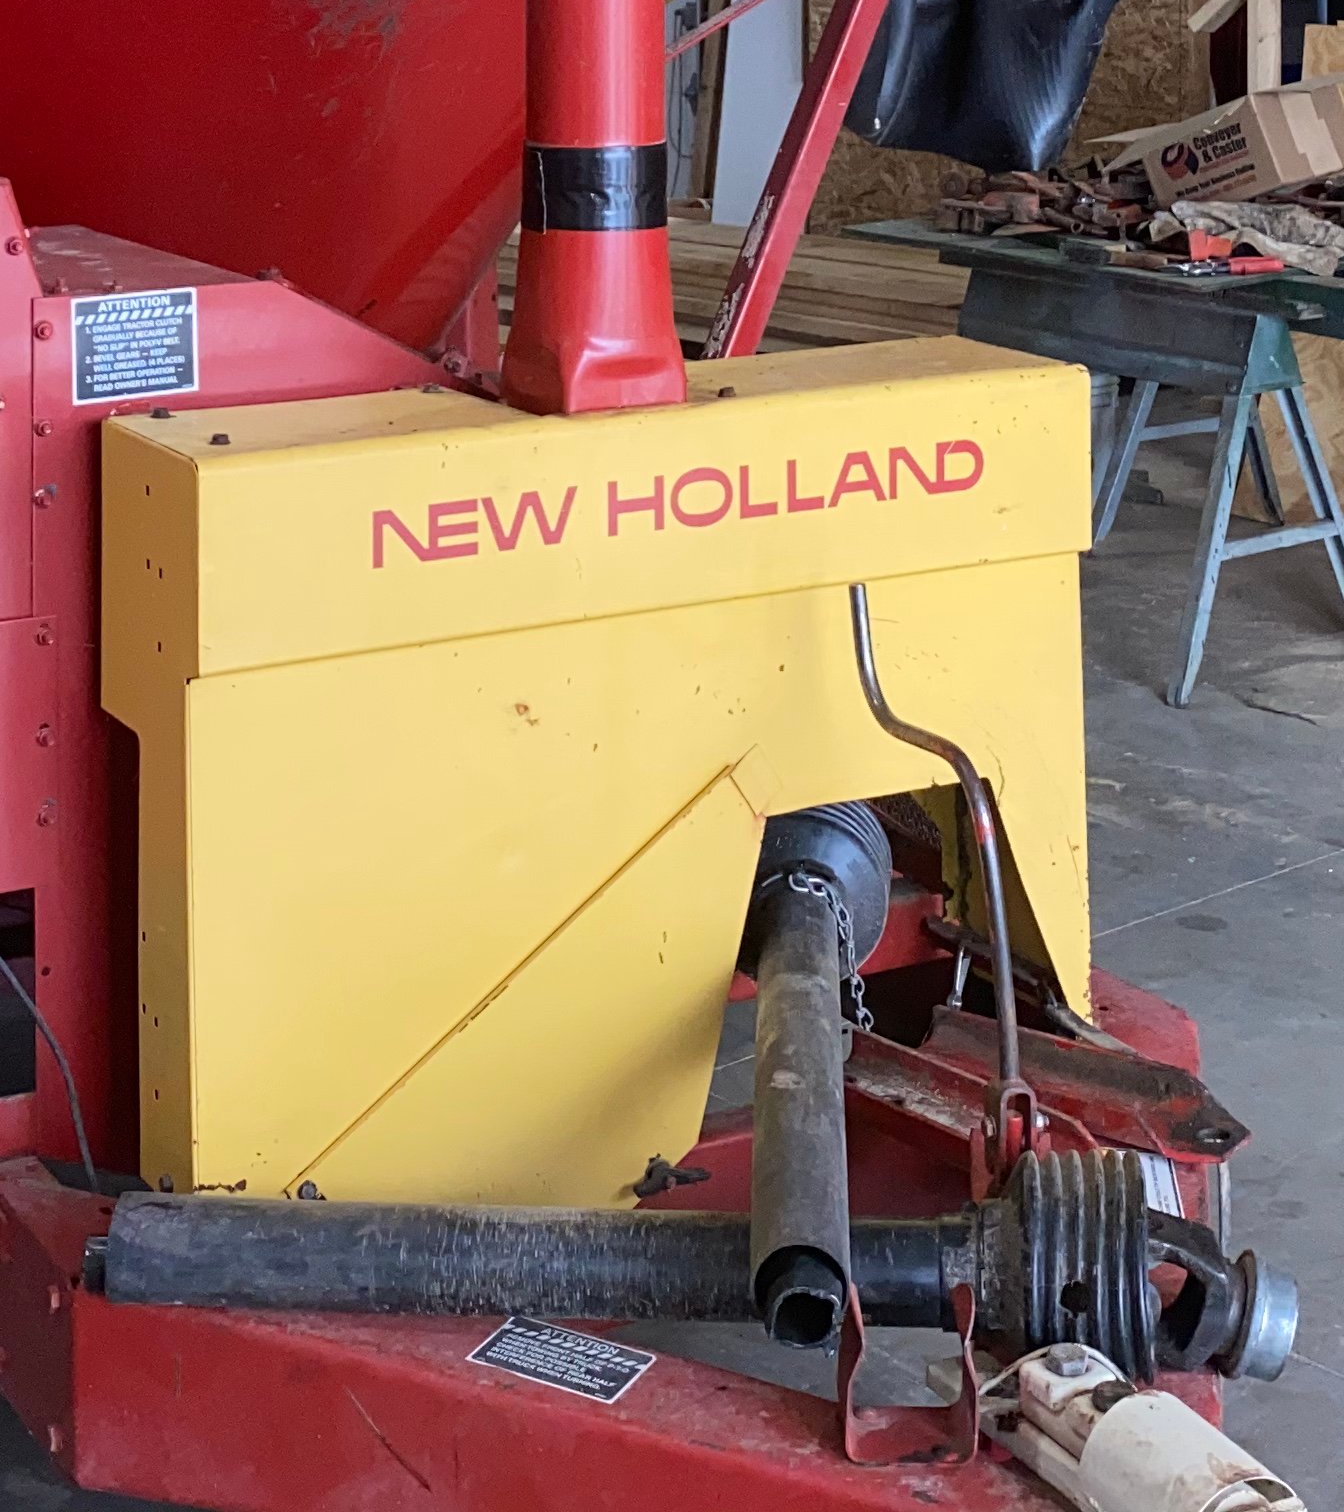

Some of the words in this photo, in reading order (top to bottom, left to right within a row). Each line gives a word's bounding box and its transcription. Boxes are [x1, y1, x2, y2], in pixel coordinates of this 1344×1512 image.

[98, 295, 171, 312] ATTENTION
[123, 320, 154, 330] TRACTOR
[156, 317, 182, 327] CLUTCH
[93, 331, 134, 343] GRADUALLY
[135, 328, 166, 339] BECAUSE
[167, 326, 177, 335] OF
[93, 354, 115, 363] BEVEL
[116, 350, 140, 361] GEARS
[94, 374, 108, 383] FOR
[110, 372, 136, 382] BETTER
[137, 367, 175, 378] OPERATION
[94, 383, 113, 392] READ
[372, 486, 578, 569] NEW
[608, 439, 984, 537] HOLLAND
[539, 1328, 620, 1354] ATTENTION
[507, 1358, 536, 1368] TRUCK
